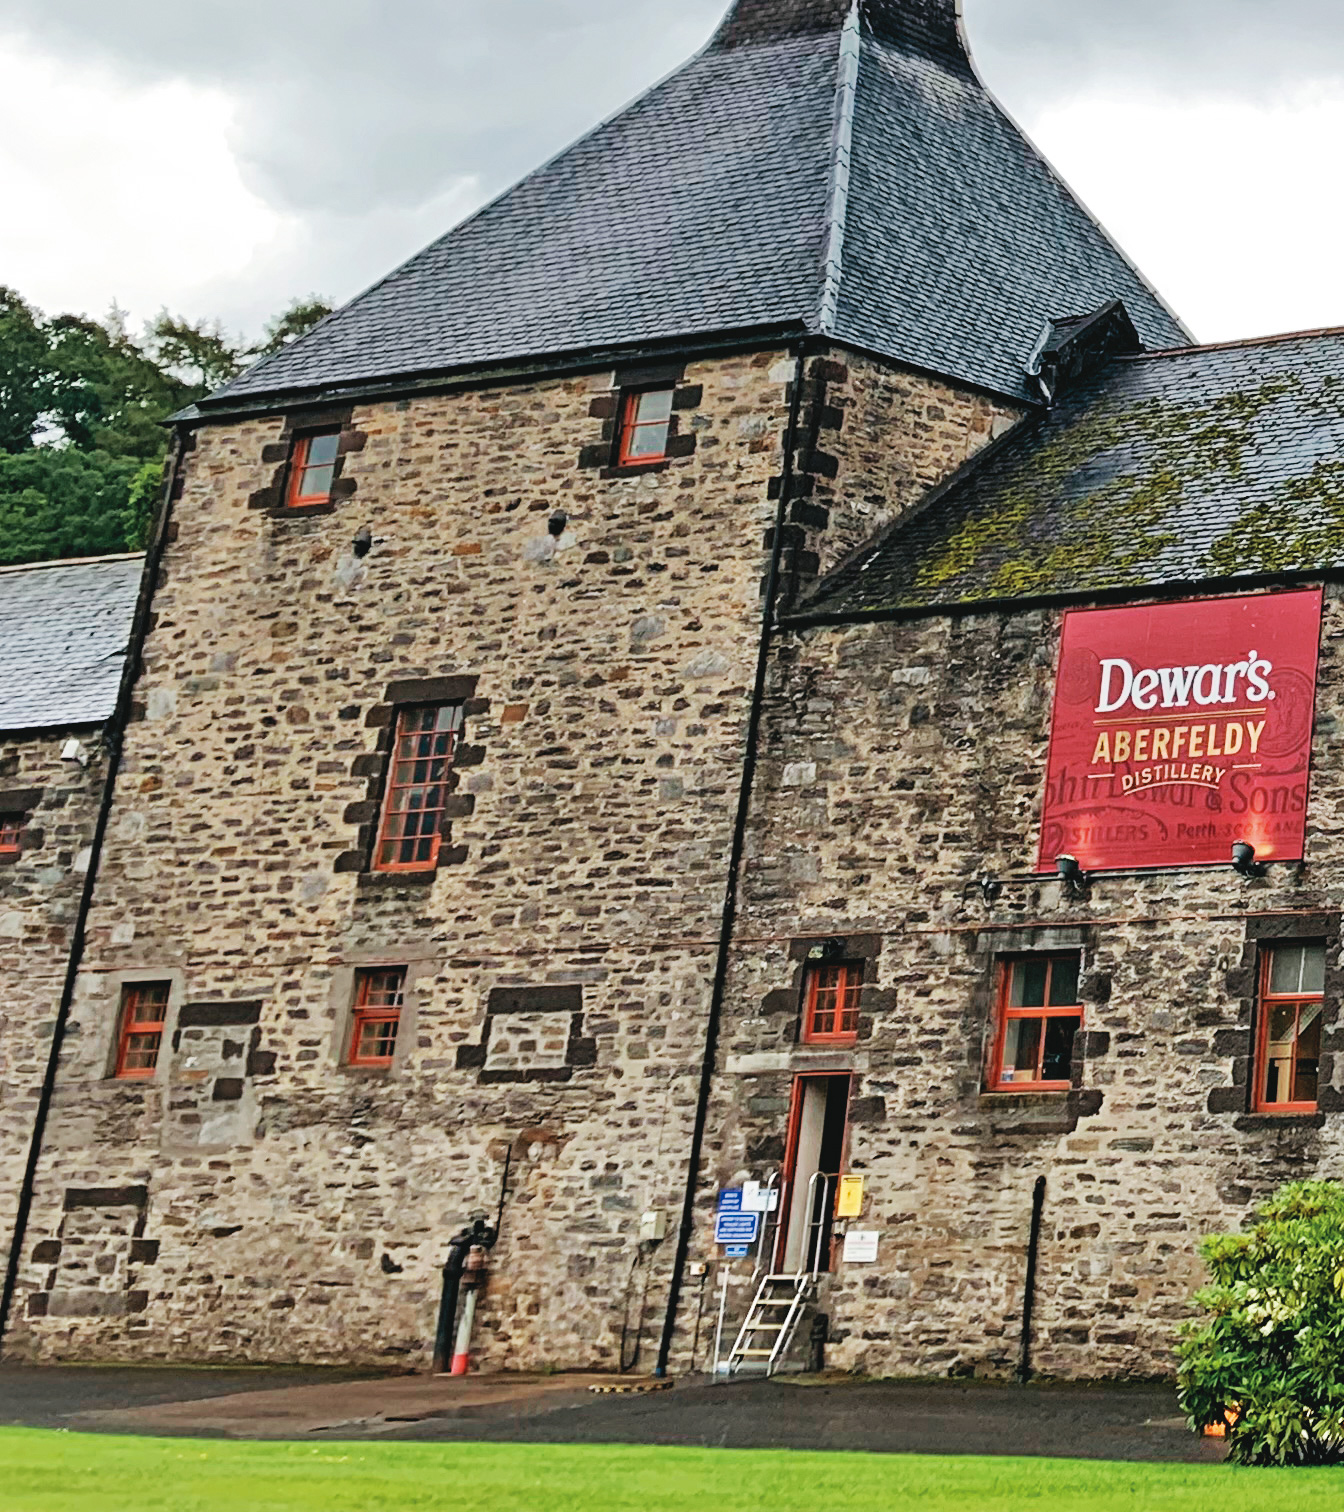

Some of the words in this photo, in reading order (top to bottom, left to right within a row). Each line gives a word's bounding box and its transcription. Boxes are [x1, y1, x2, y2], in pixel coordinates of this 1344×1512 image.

[1091, 720, 1266, 764] ABERFELDY
[1121, 763, 1226, 791] DISTILLERY
[1229, 771, 1305, 815] Sons
[1177, 821, 1216, 838] Perth
